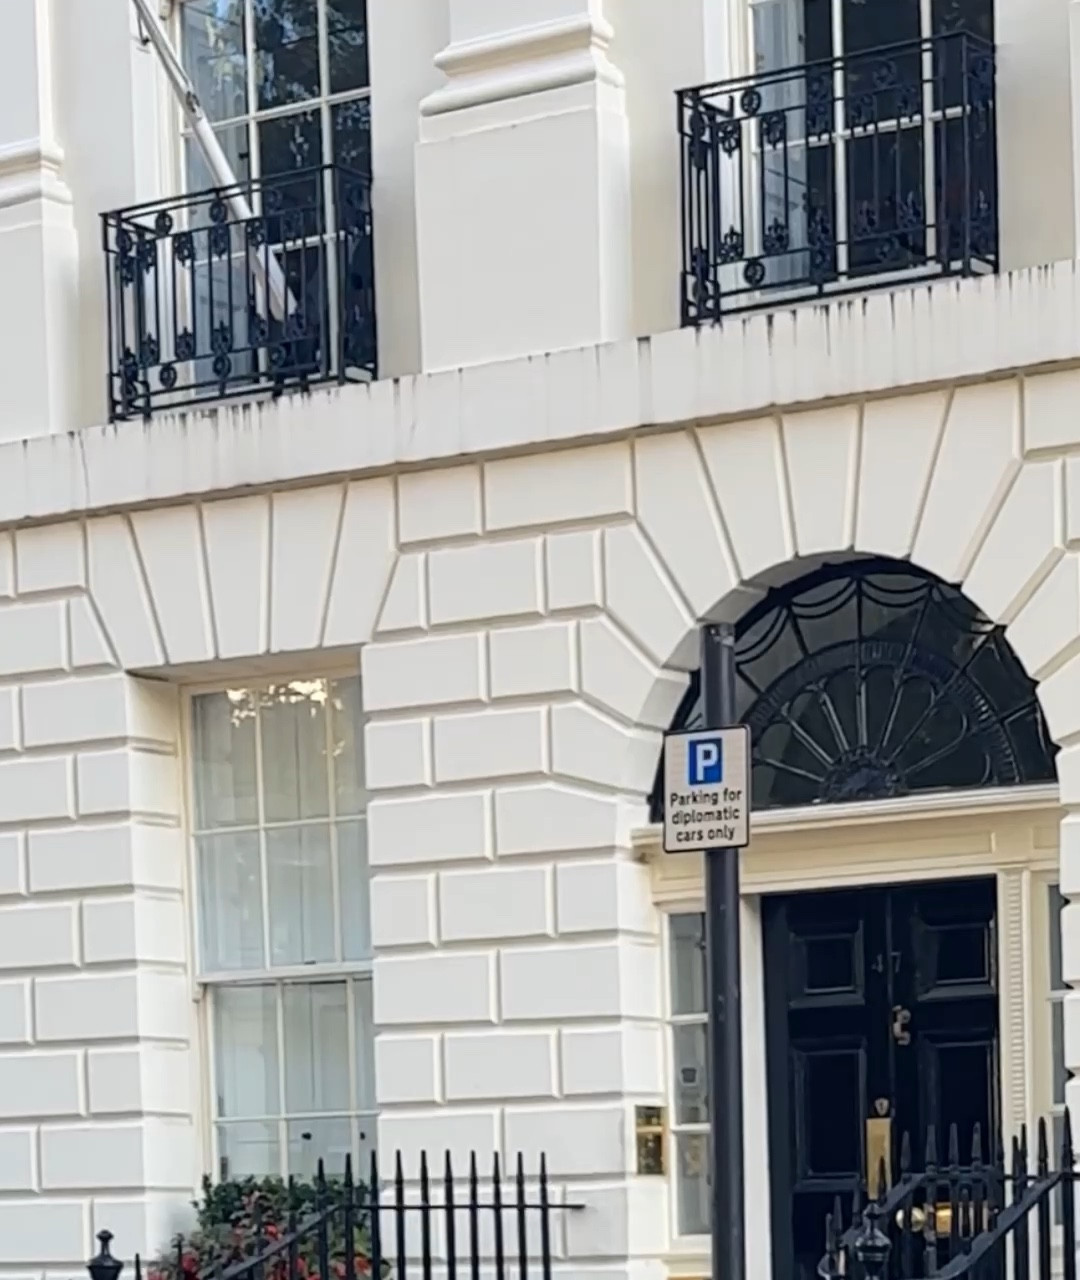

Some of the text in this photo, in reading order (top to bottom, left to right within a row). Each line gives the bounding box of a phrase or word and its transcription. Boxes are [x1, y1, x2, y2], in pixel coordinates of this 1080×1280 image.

[696, 743, 719, 781] P
[670, 787, 742, 807] Parking for
[672, 807, 740, 826] diplomatic
[676, 825, 735, 842] cars only
